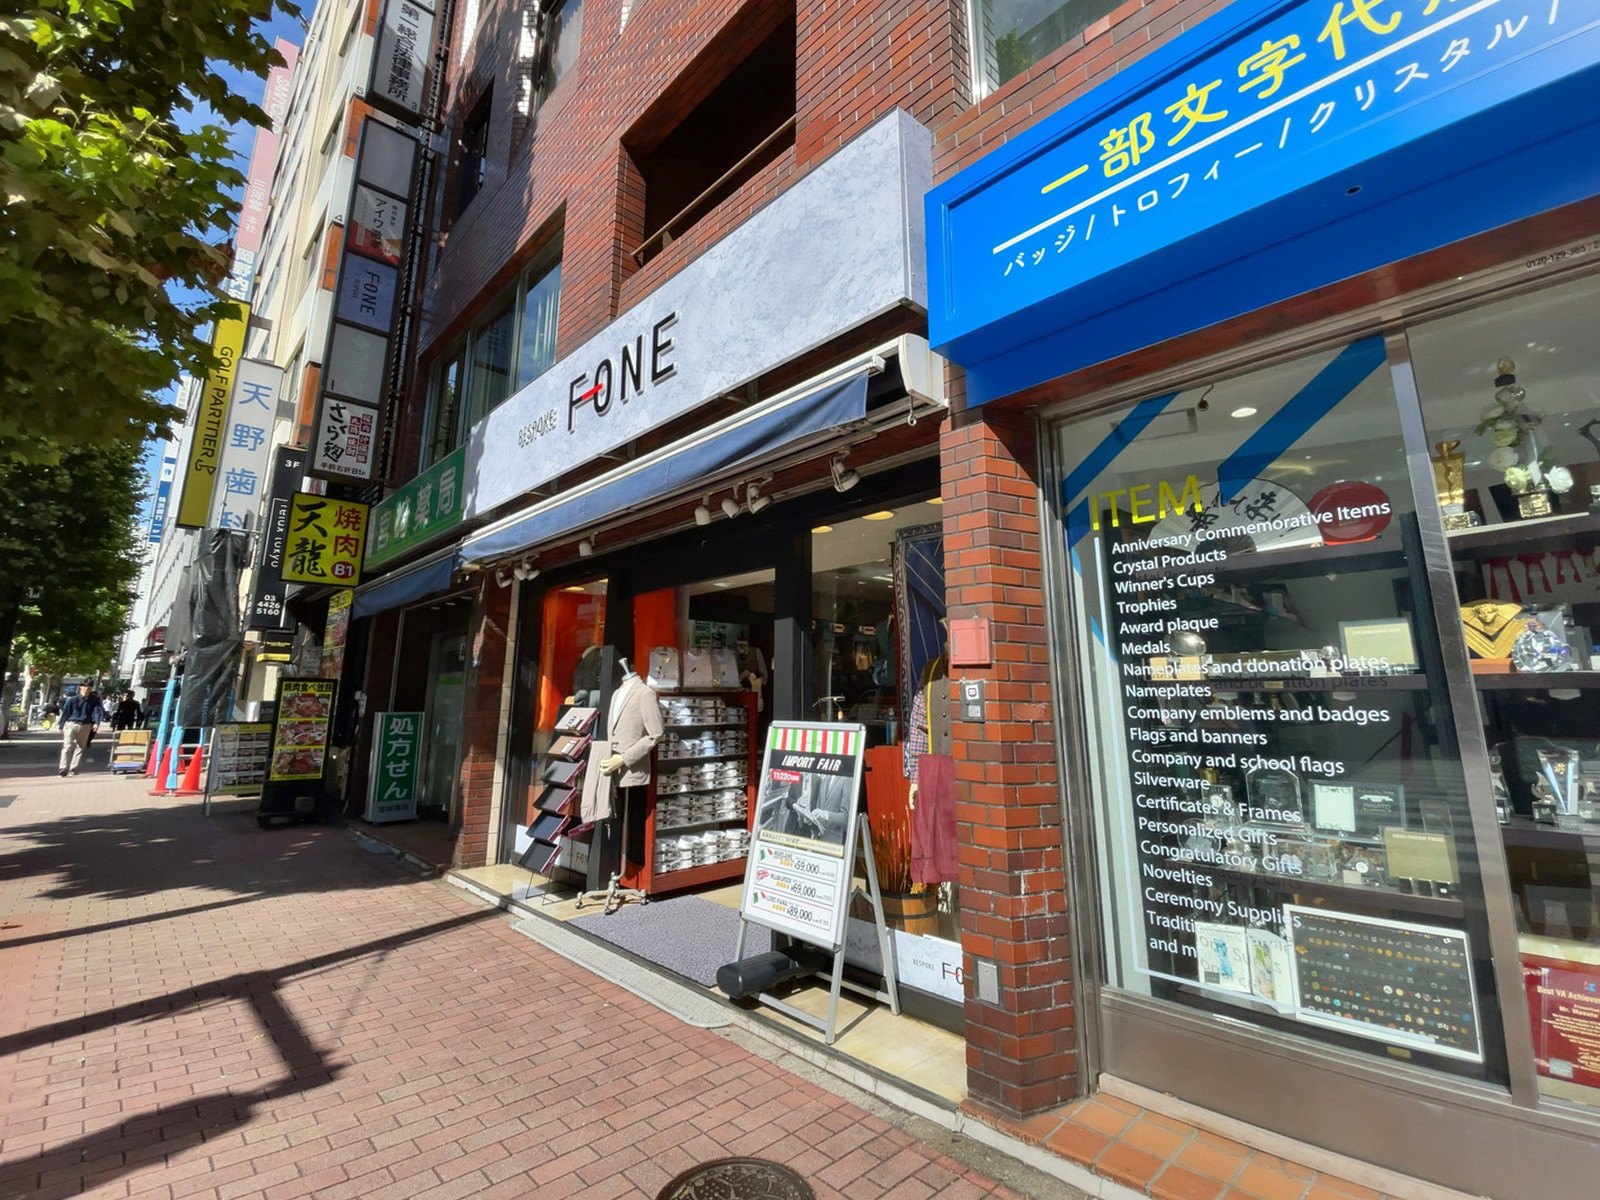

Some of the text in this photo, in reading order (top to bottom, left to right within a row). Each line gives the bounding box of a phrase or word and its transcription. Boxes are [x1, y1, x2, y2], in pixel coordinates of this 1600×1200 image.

[1041, 0, 1470, 193] 一部文字代
[359, 269, 381, 316] FONE
[518, 310, 681, 448] BESPOKE FONE
[284, 459, 300, 469] 3F
[1090, 474, 1203, 531] ITEM
[288, 502, 328, 577] 天龍
[1111, 531, 1192, 555] Anniversary
[1195, 509, 1333, 543] Commemorative
[1337, 500, 1391, 522] Items
[333, 563, 354, 577] B1
[1113, 548, 1228, 576] Crystal Products
[1115, 571, 1215, 595] Winner's Cups
[256, 608, 280, 616] 5160
[257, 601, 281, 609] 4426
[1117, 597, 1178, 616] Trophies
[1119, 615, 1219, 635] Award plaque
[1121, 640, 1171, 656] Medals
[1123, 654, 1389, 679] Nameplates and donation plates
[1126, 683, 1212, 702] Nameplates
[1127, 704, 1390, 728] Company emblems and badges
[1129, 727, 1268, 746] Flags and banners
[383, 717, 414, 800] 処方せん
[781, 754, 841, 771] IMPORT FAIR
[1131, 749, 1345, 776] Company and school flags
[1134, 772, 1210, 791] Silverware
[1136, 794, 1301, 823] Certificates & Frames
[1138, 817, 1277, 846] Personalized Gifts
[1140, 840, 1303, 875] Congratulatory Gifts
[1143, 863, 1213, 888] Novelties
[1145, 887, 1302, 928] Ceremony Supplies
[1149, 936, 1178, 955] and
[913, 958, 935, 971] BESPOKE
